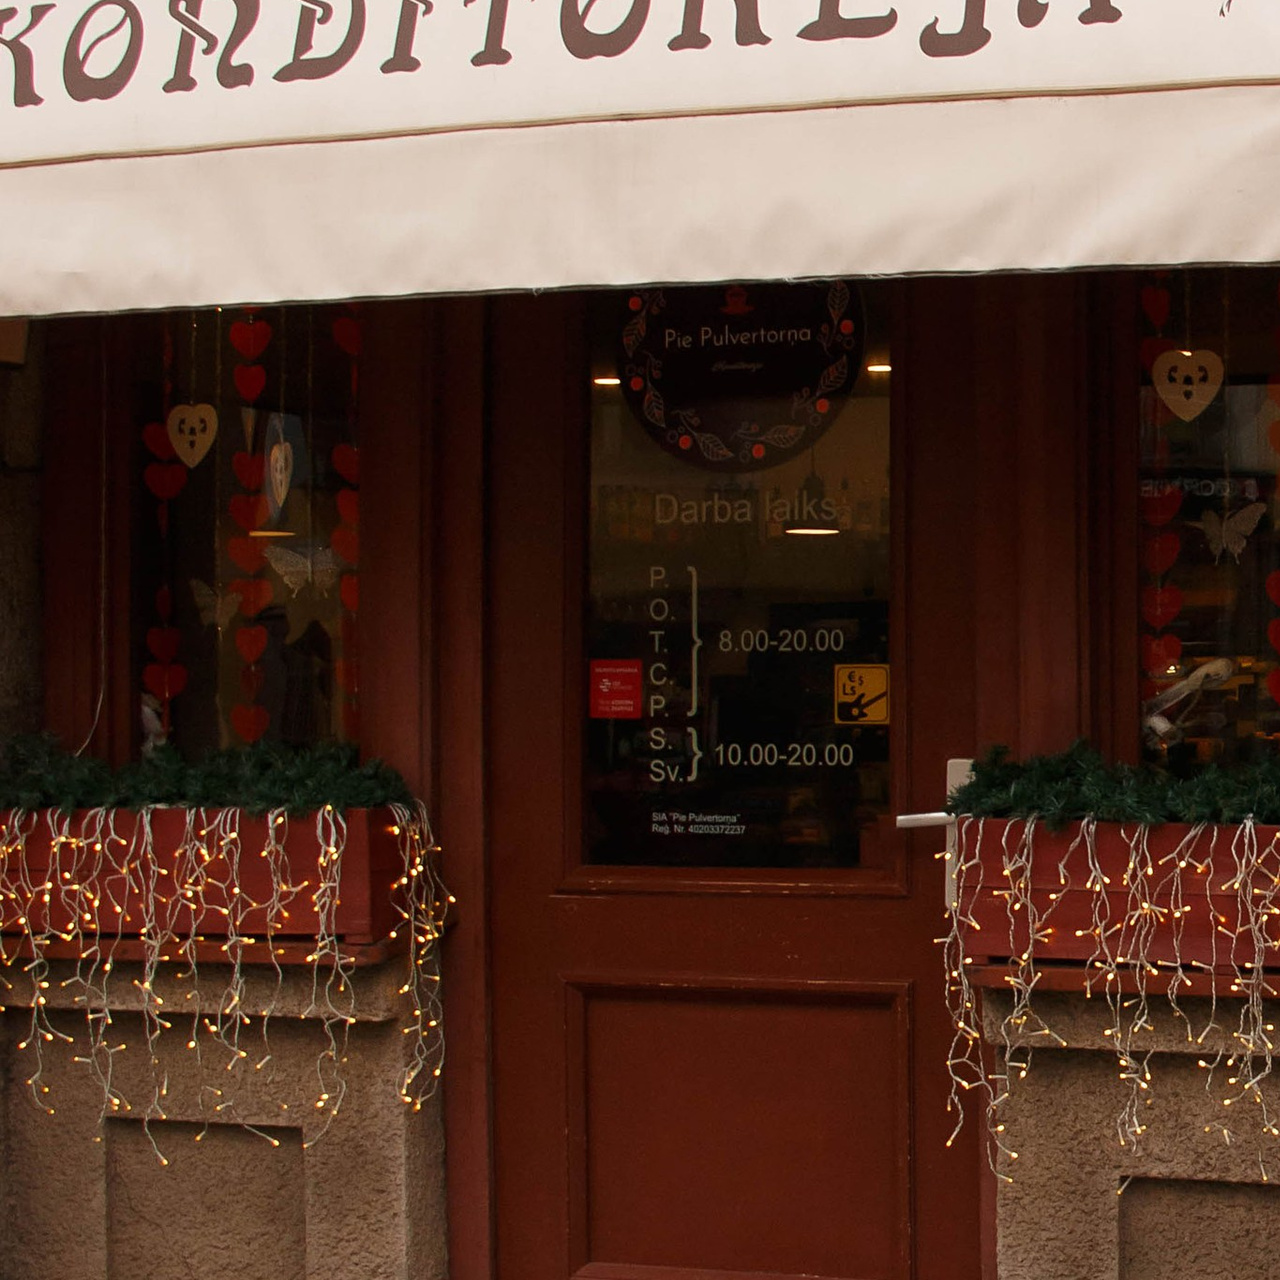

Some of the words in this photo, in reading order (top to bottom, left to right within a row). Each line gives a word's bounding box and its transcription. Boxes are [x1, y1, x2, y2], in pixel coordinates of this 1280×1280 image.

[665, 329, 692, 348] Pie
[700, 325, 811, 348] Pulvertorņa
[655, 493, 752, 523] Darba
[765, 490, 838, 521] laiks
[650, 567, 669, 588] P.
[649, 631, 668, 653] T.
[719, 629, 844, 651] 8.00-20.00
[649, 663, 674, 686] C.
[650, 695, 669, 718] P.
[649, 727, 673, 750] S.
[714, 744, 853, 766] 10.00-20.00
[649, 760, 684, 782] Sv.
[652, 812, 668, 822] SIA
